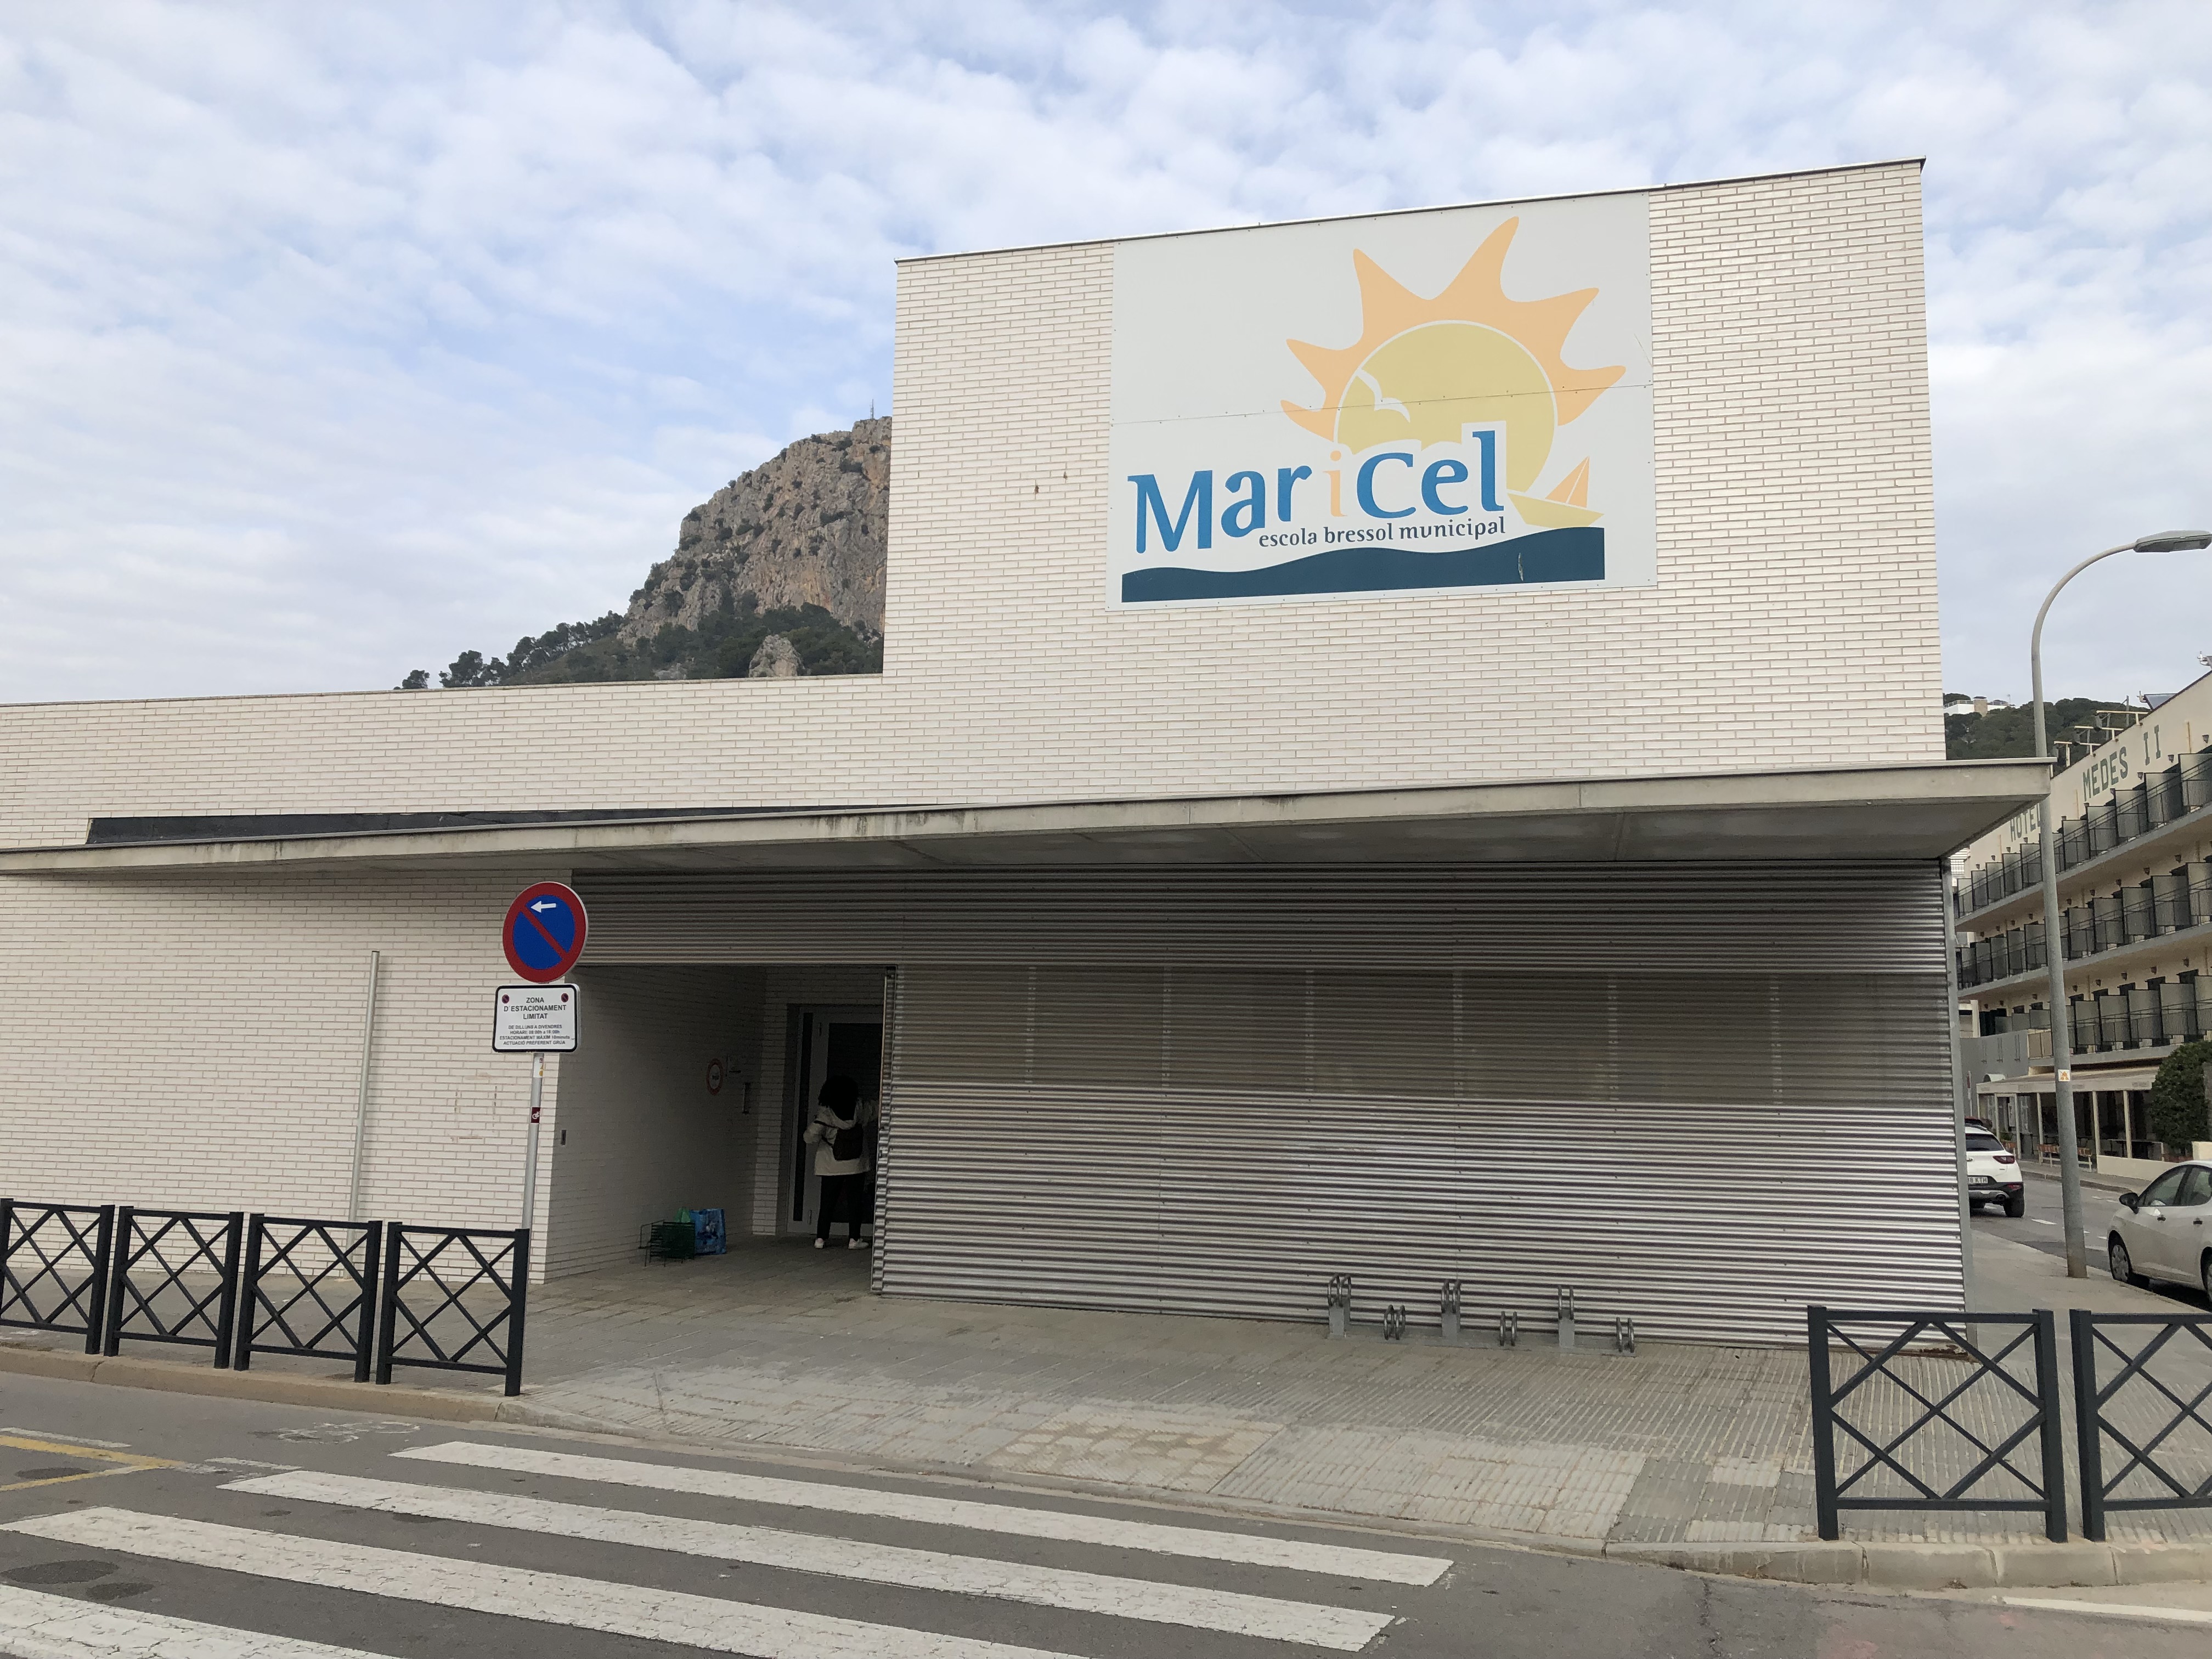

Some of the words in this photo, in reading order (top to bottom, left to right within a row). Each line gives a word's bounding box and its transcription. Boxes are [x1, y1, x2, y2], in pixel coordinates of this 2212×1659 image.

[1259, 528, 1317, 548] escola
[1324, 523, 1393, 543] bressol
[1400, 516, 1506, 540] municipal
[2010, 802, 2041, 842] HOTEL
[2083, 746, 2128, 802] MEDES
